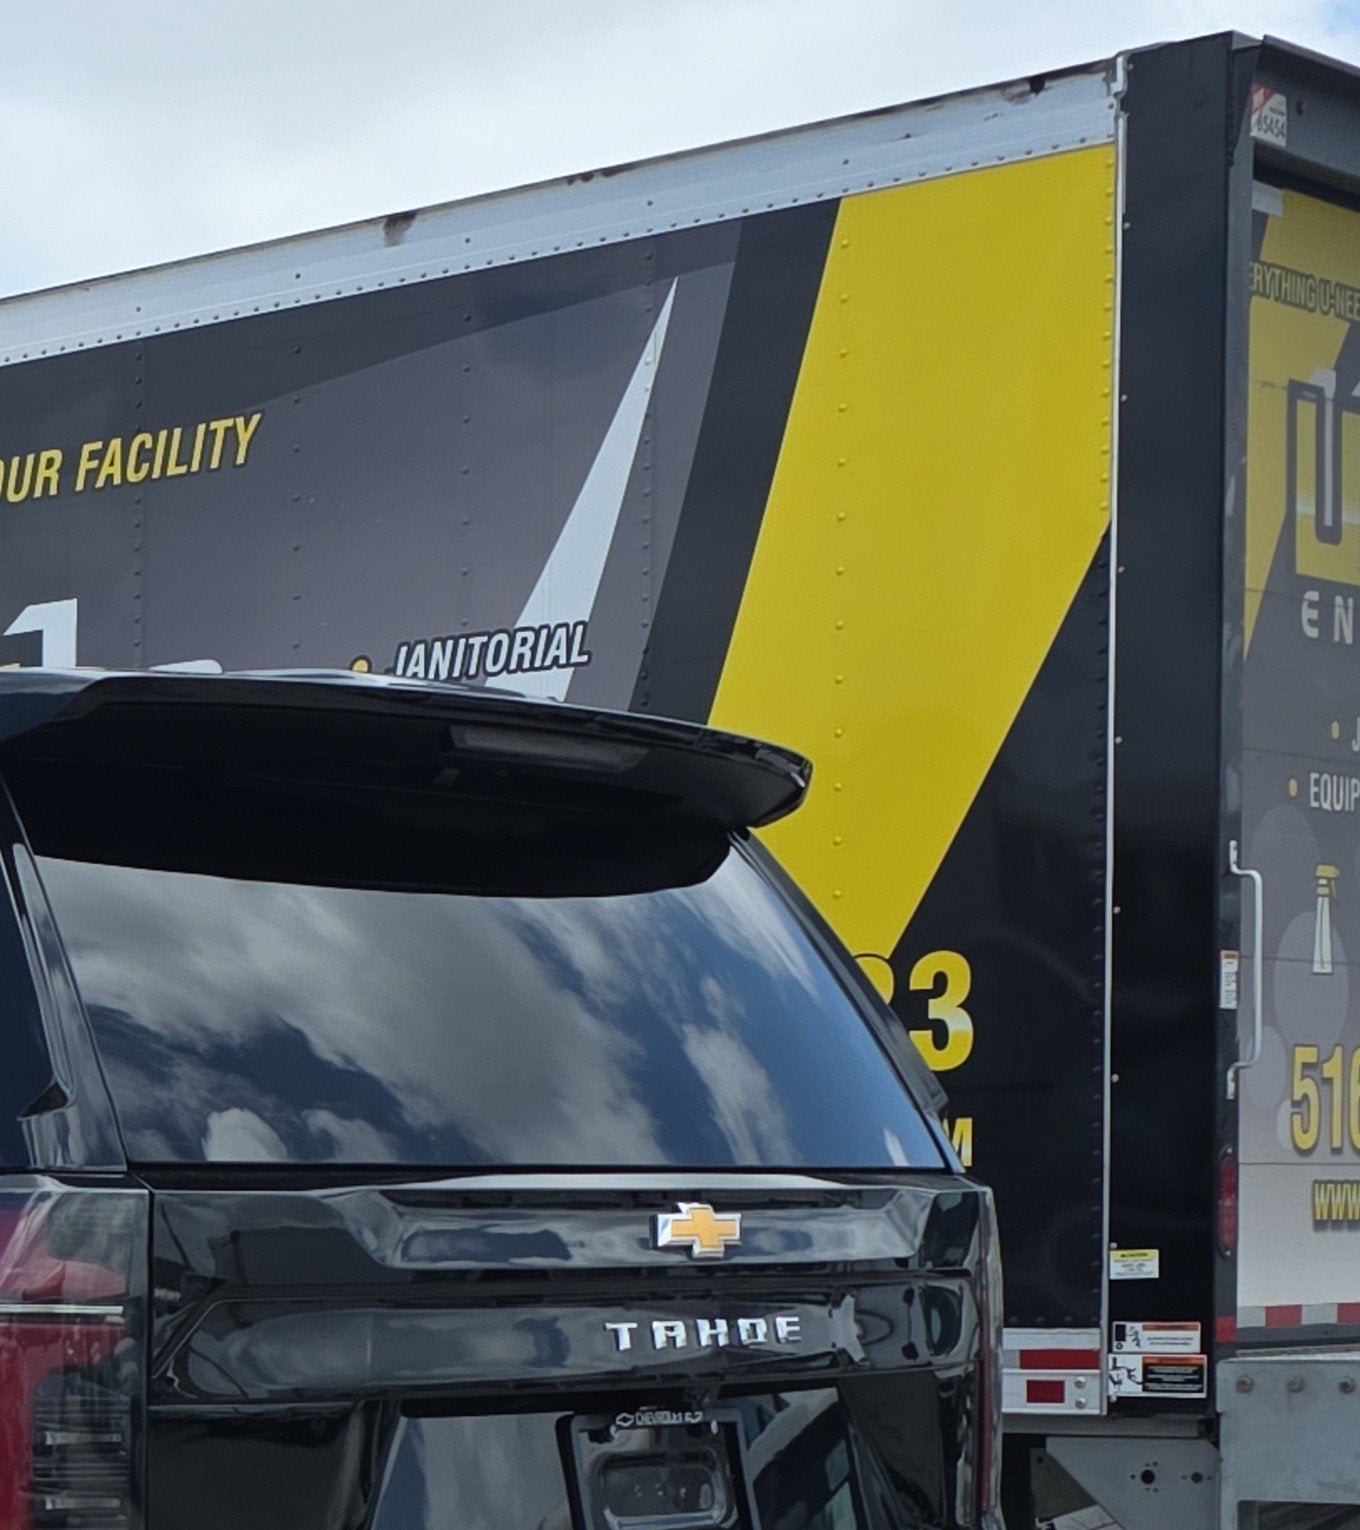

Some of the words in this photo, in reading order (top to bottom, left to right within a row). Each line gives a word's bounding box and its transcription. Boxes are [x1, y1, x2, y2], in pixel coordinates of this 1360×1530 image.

[74, 413, 263, 492] FACILITY
[1310, 772, 1360, 812] EQUIP
[605, 1315, 802, 1352] TAHOE
